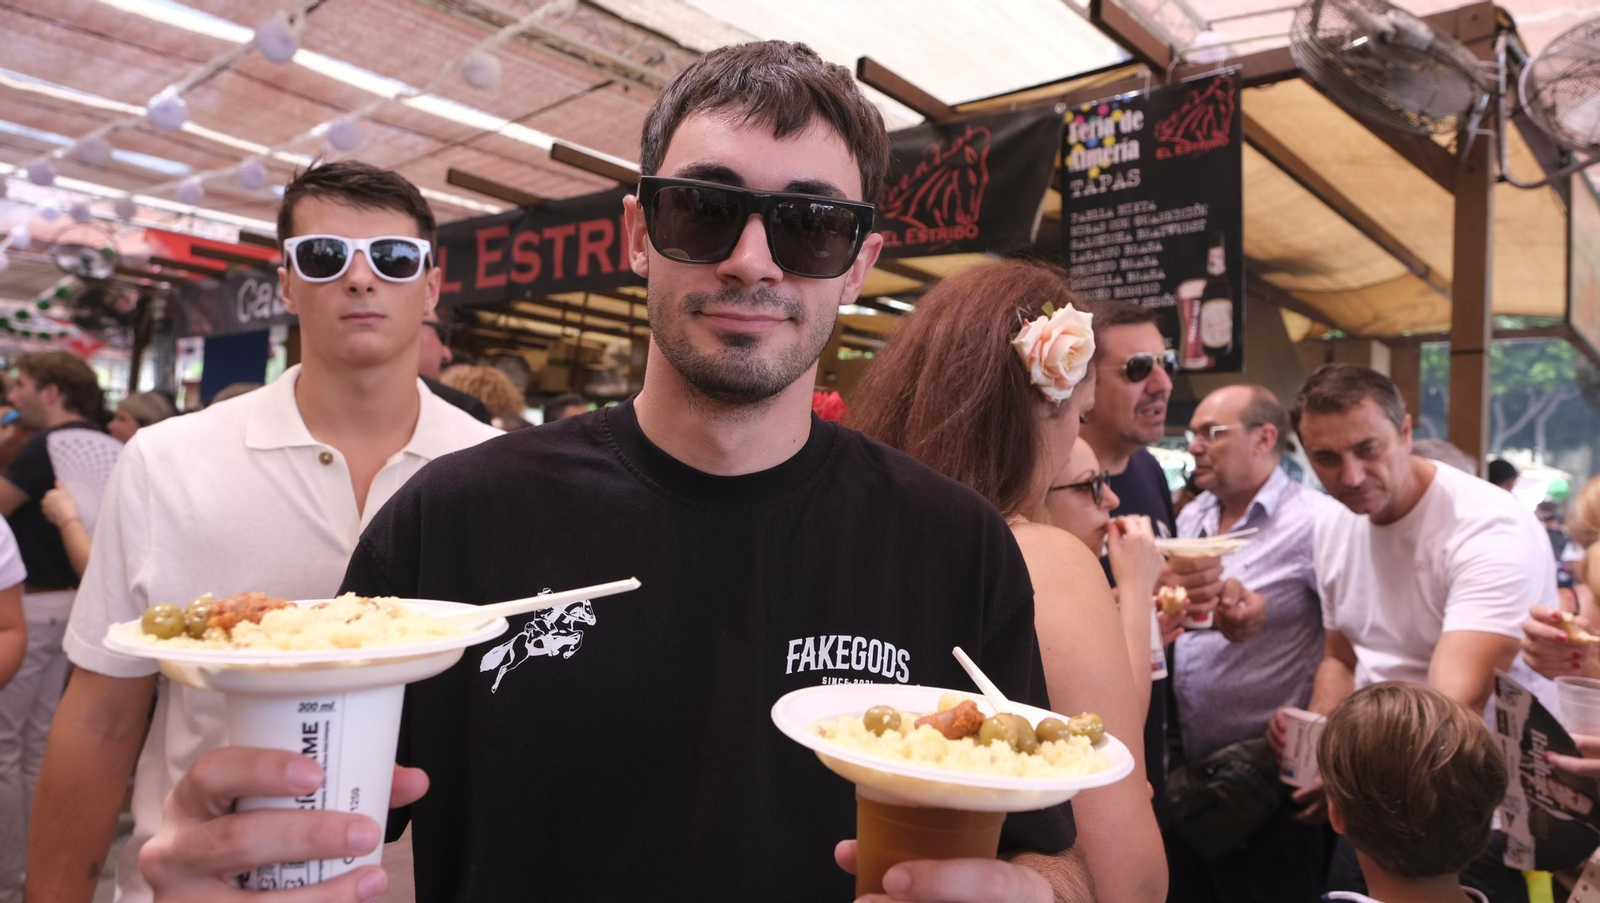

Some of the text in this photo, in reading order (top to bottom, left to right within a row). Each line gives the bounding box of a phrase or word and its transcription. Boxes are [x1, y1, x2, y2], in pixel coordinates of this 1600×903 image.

[1068, 109, 1145, 145] Feria de
[1069, 168, 1141, 199] TAPAS
[436, 213, 632, 294] L ESTRI
[785, 634, 911, 684] FAKEGODS
[822, 676, 851, 685] SINCE
